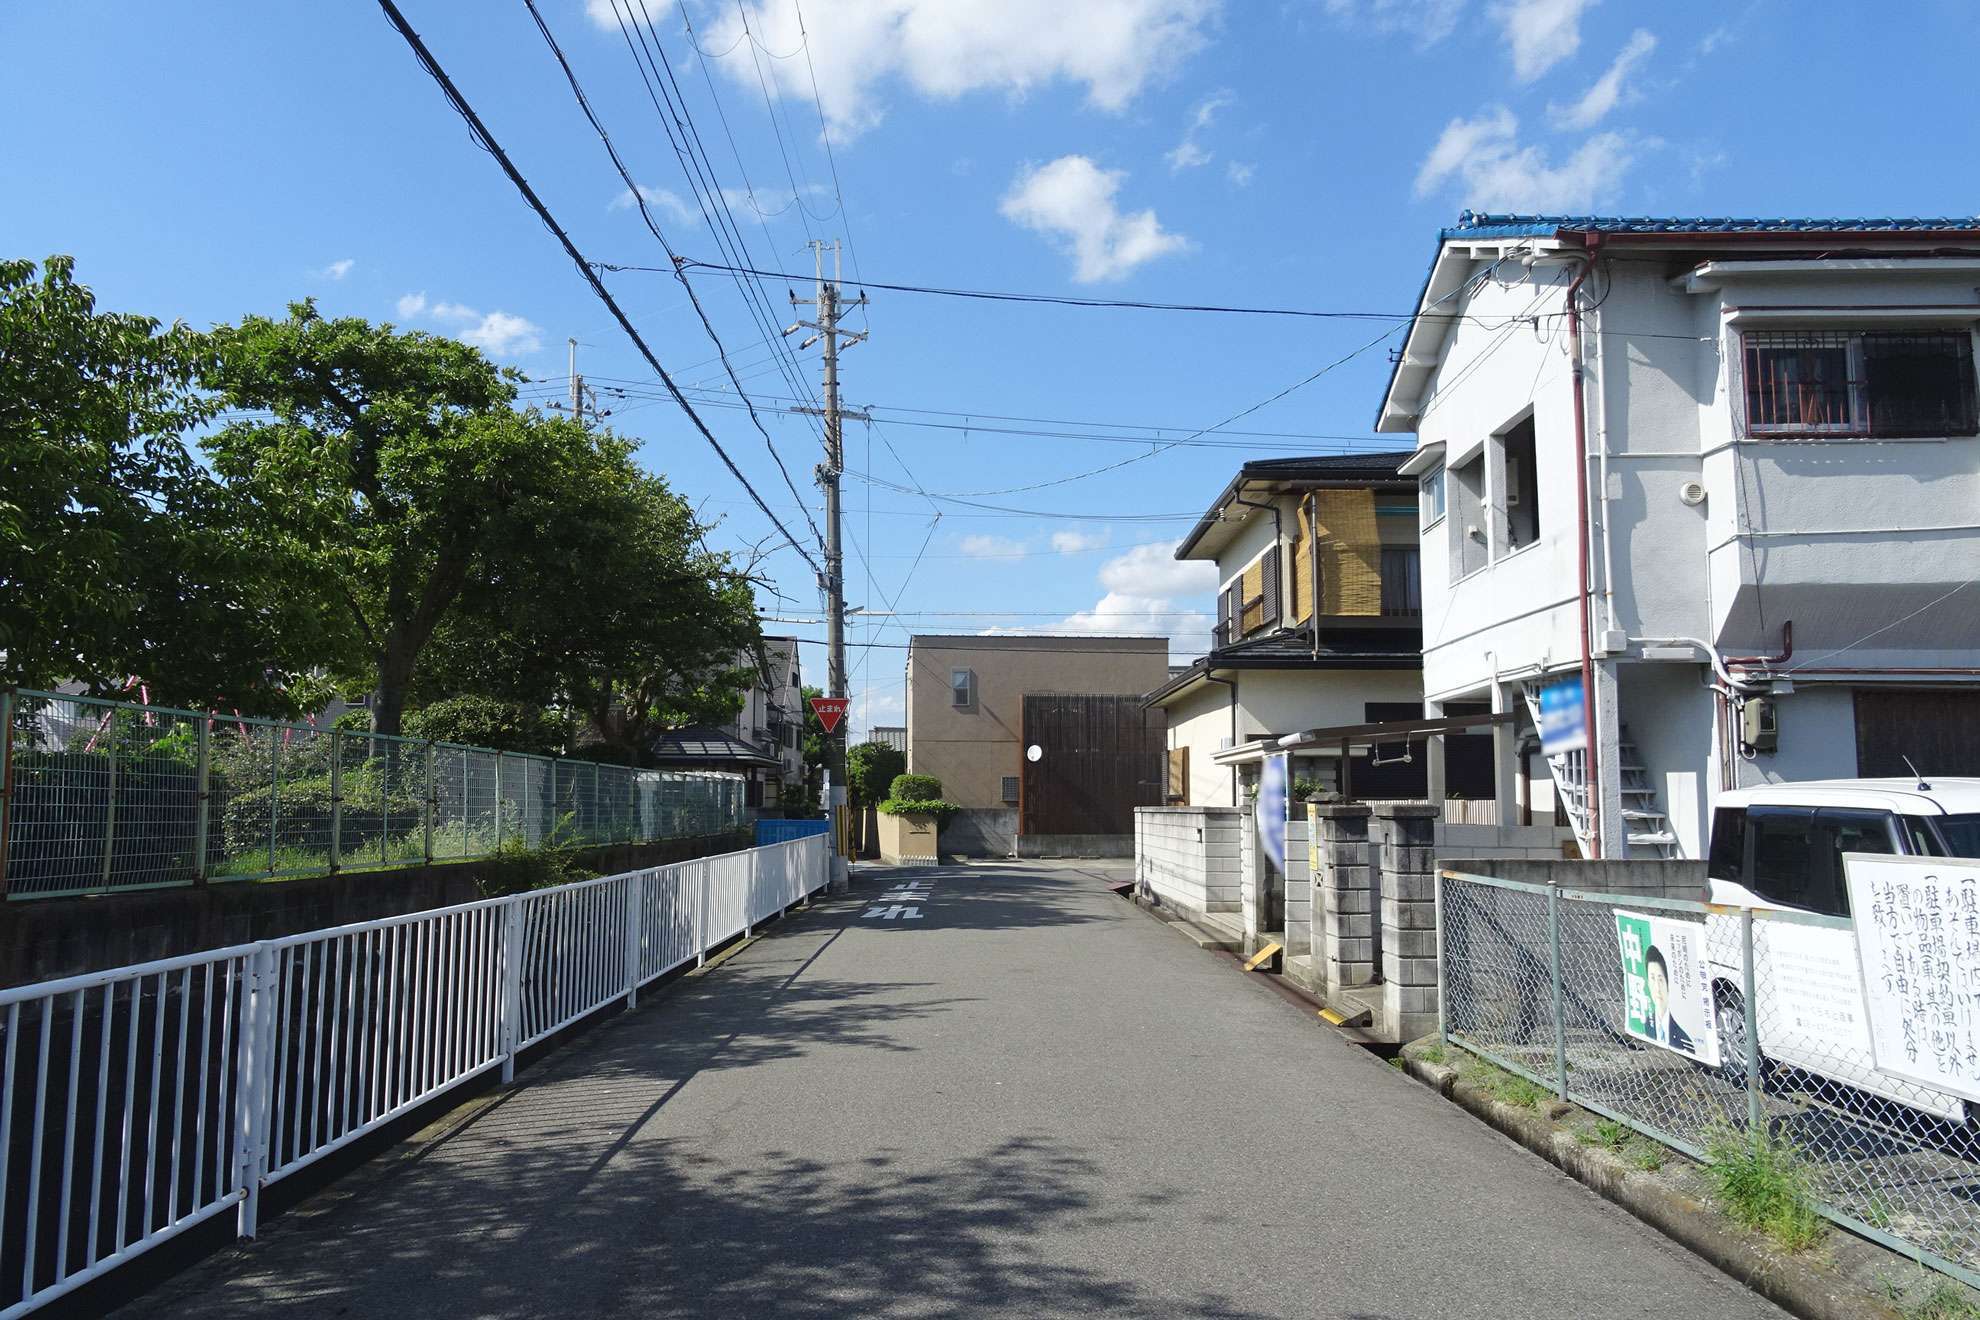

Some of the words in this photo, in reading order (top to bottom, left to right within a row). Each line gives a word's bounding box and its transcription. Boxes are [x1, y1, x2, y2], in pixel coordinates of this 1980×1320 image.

[818, 705, 841, 713] 止まれ
[860, 881, 935, 920] 止まれ
[1621, 923, 1649, 1024] 中野
